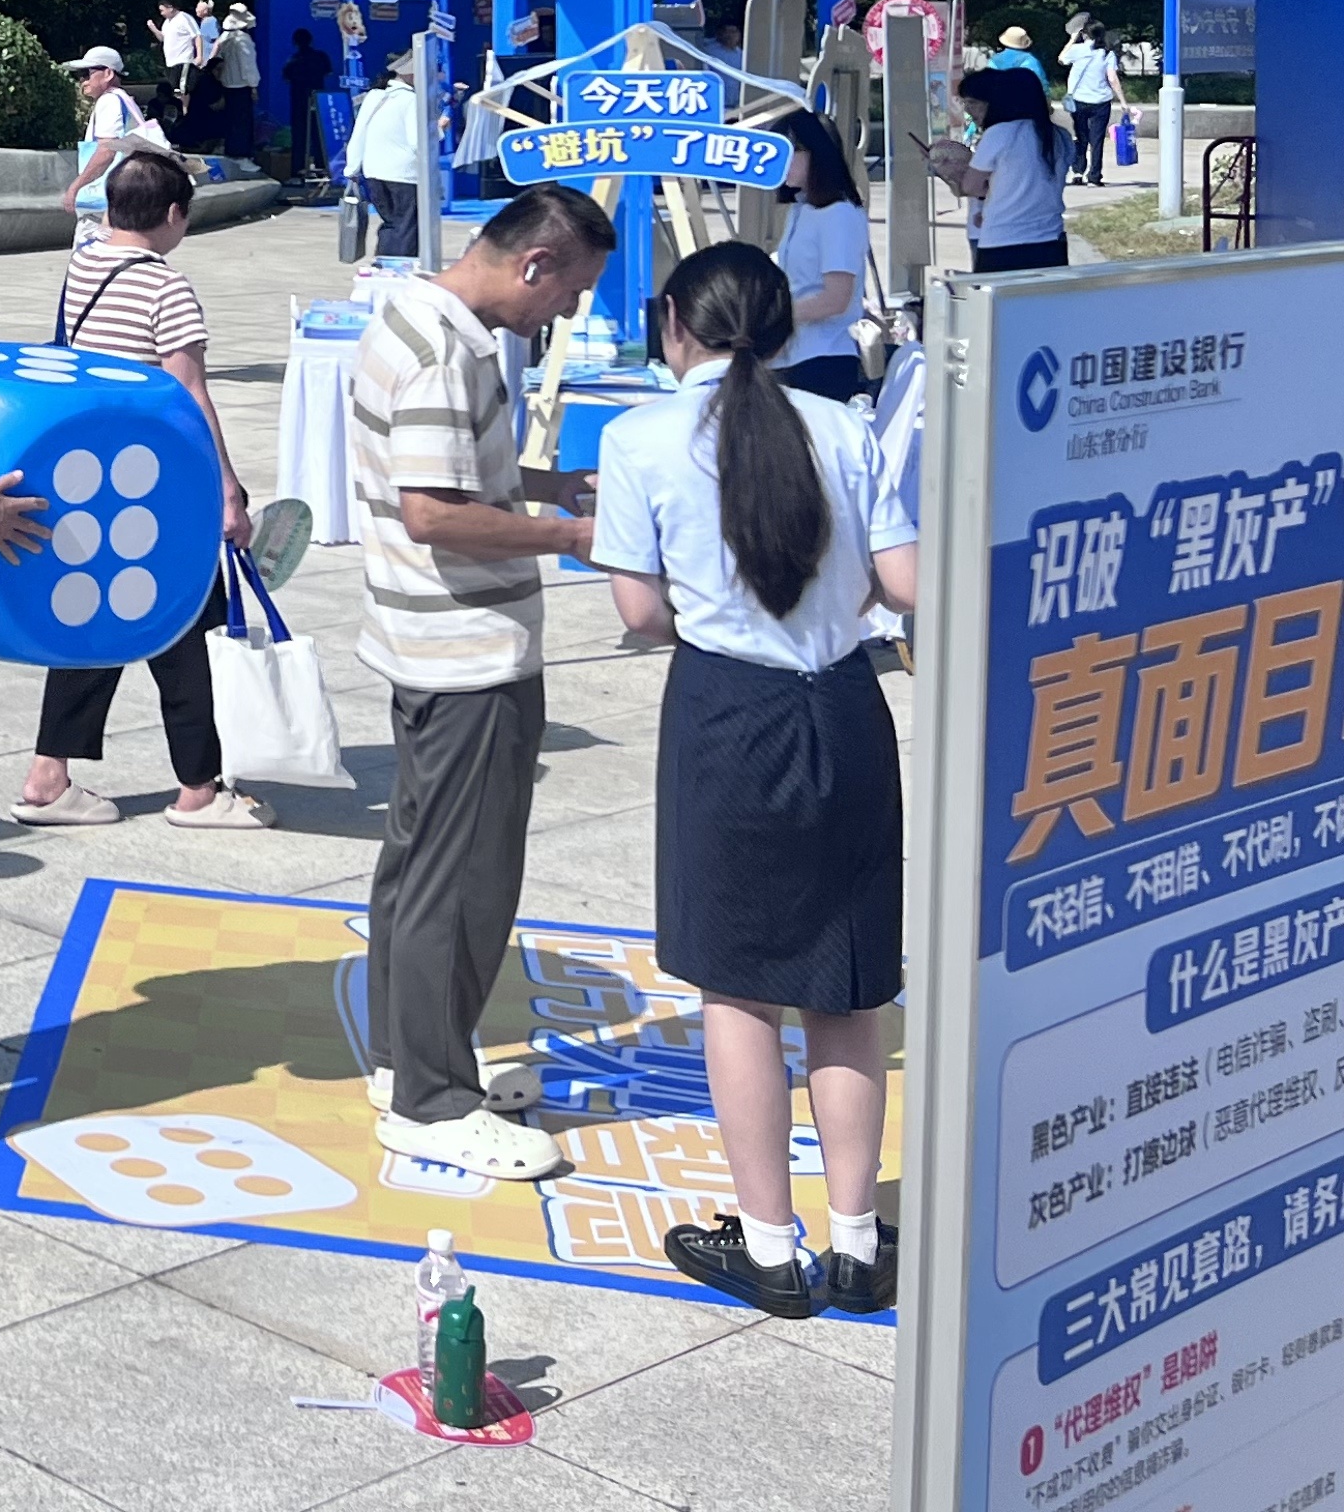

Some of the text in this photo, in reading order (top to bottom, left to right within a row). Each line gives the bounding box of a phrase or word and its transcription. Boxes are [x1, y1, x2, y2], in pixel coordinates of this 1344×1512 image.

[579, 77, 709, 115] 今天你
[1070, 332, 1245, 389] 中国建设银行
[1068, 379, 1222, 418] China Construction Bank
[1066, 423, 1150, 461] 山东省分行
[1006, 580, 1344, 864] 真面目
[1168, 896, 1344, 1014] 什么是黑灰产
